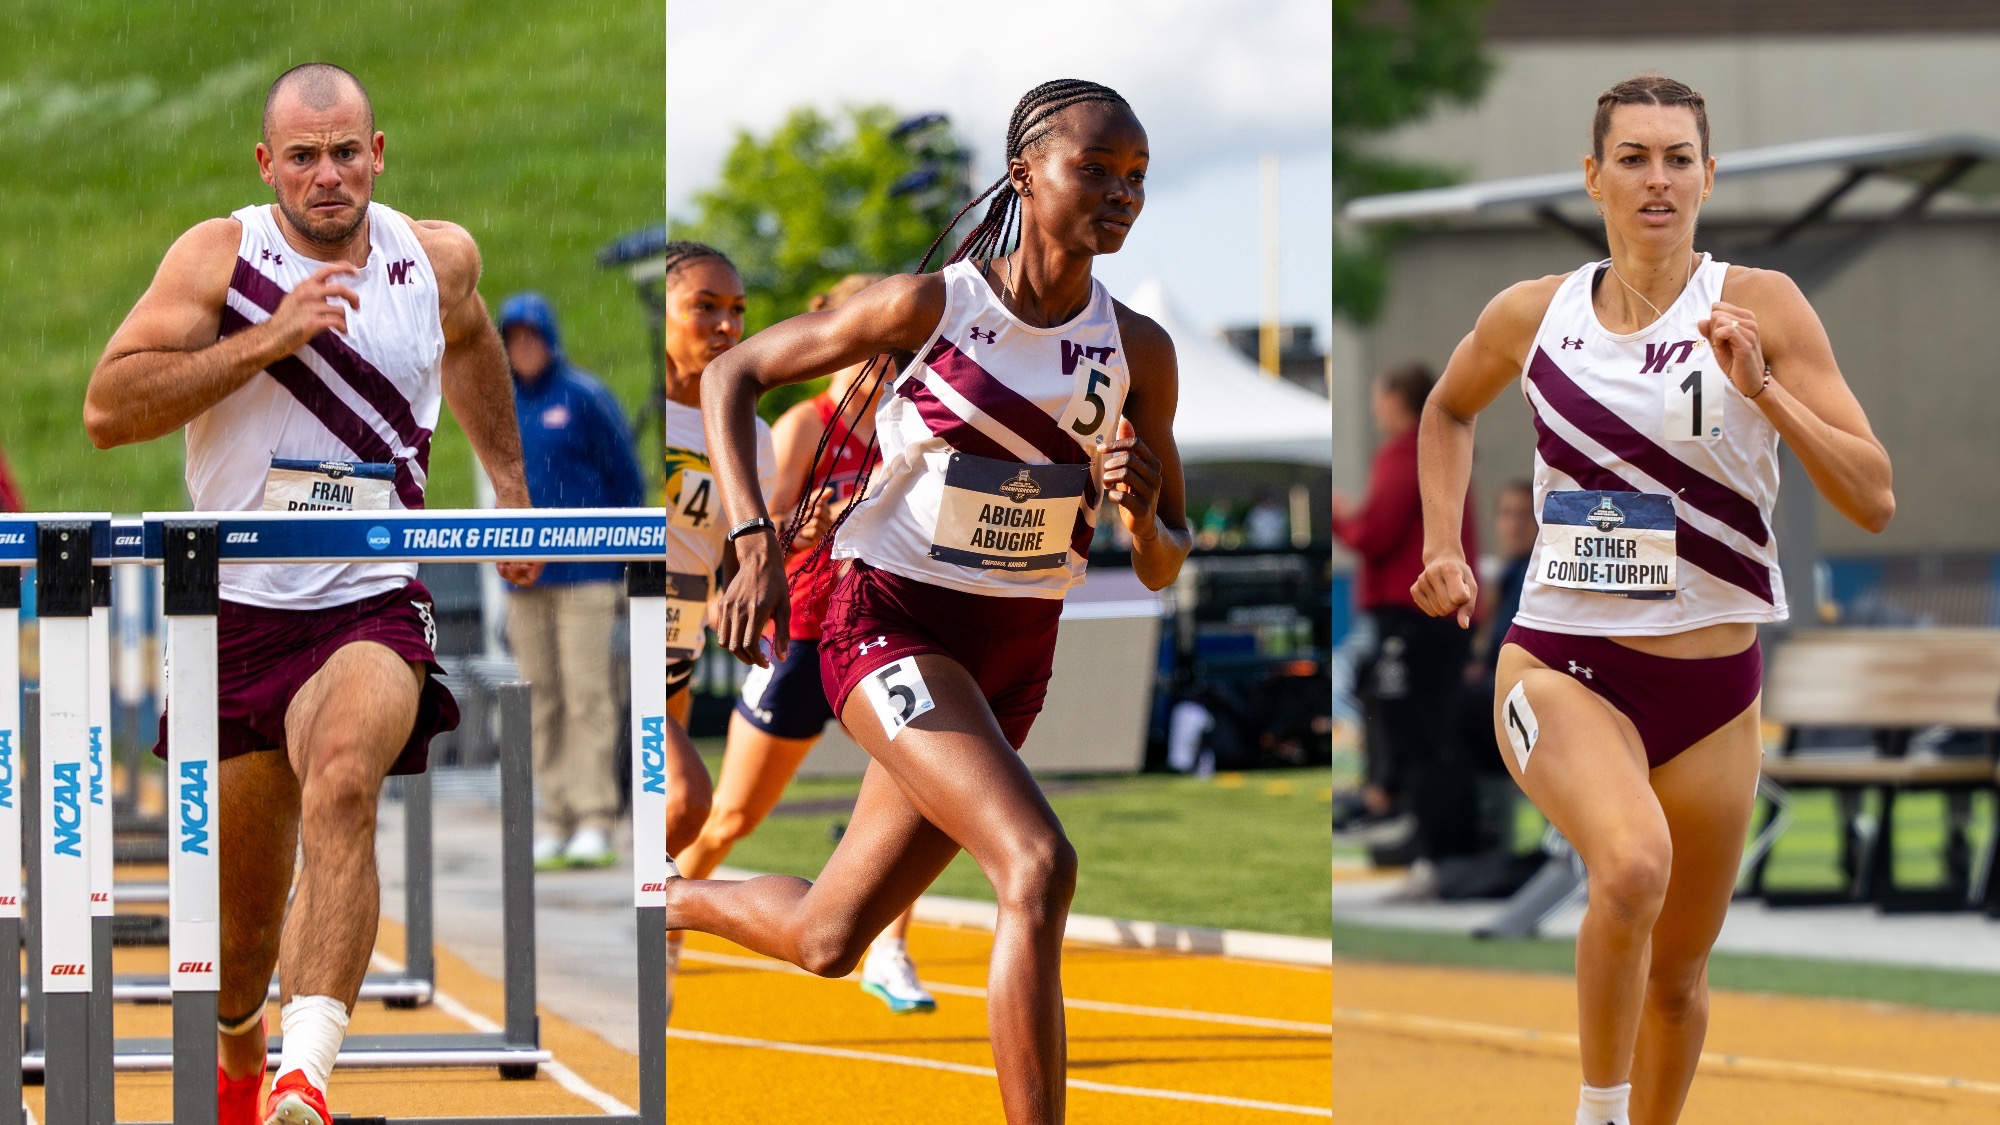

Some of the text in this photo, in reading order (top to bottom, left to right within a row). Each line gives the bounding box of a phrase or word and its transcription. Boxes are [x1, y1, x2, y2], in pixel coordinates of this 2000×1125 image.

[1639, 340, 1698, 374] WT
[1072, 368, 1111, 436] 5
[1680, 371, 1702, 436] 1
[312, 481, 354, 504] FRAN
[683, 479, 711, 527] 4
[978, 503, 1046, 528] ABIGAIL
[115, 536, 141, 545] GILL
[226, 532, 258, 543] GILL
[370, 537, 390, 545] NCAA
[403, 526, 666, 549] TRACK & FIELD CHAMPIONSH
[970, 528, 1045, 552] ABUGIRE
[1574, 536, 1637, 559] ESTHER
[1547, 560, 1668, 585] CONDE-TURPIN
[876, 663, 916, 727] 5
[1509, 699, 1530, 753] 1
[642, 715, 666, 796] NCAA
[54, 762, 81, 858] NCAA
[181, 760, 208, 857] NCAA
[51, 964, 86, 976] GILL
[178, 961, 213, 974] GILL
